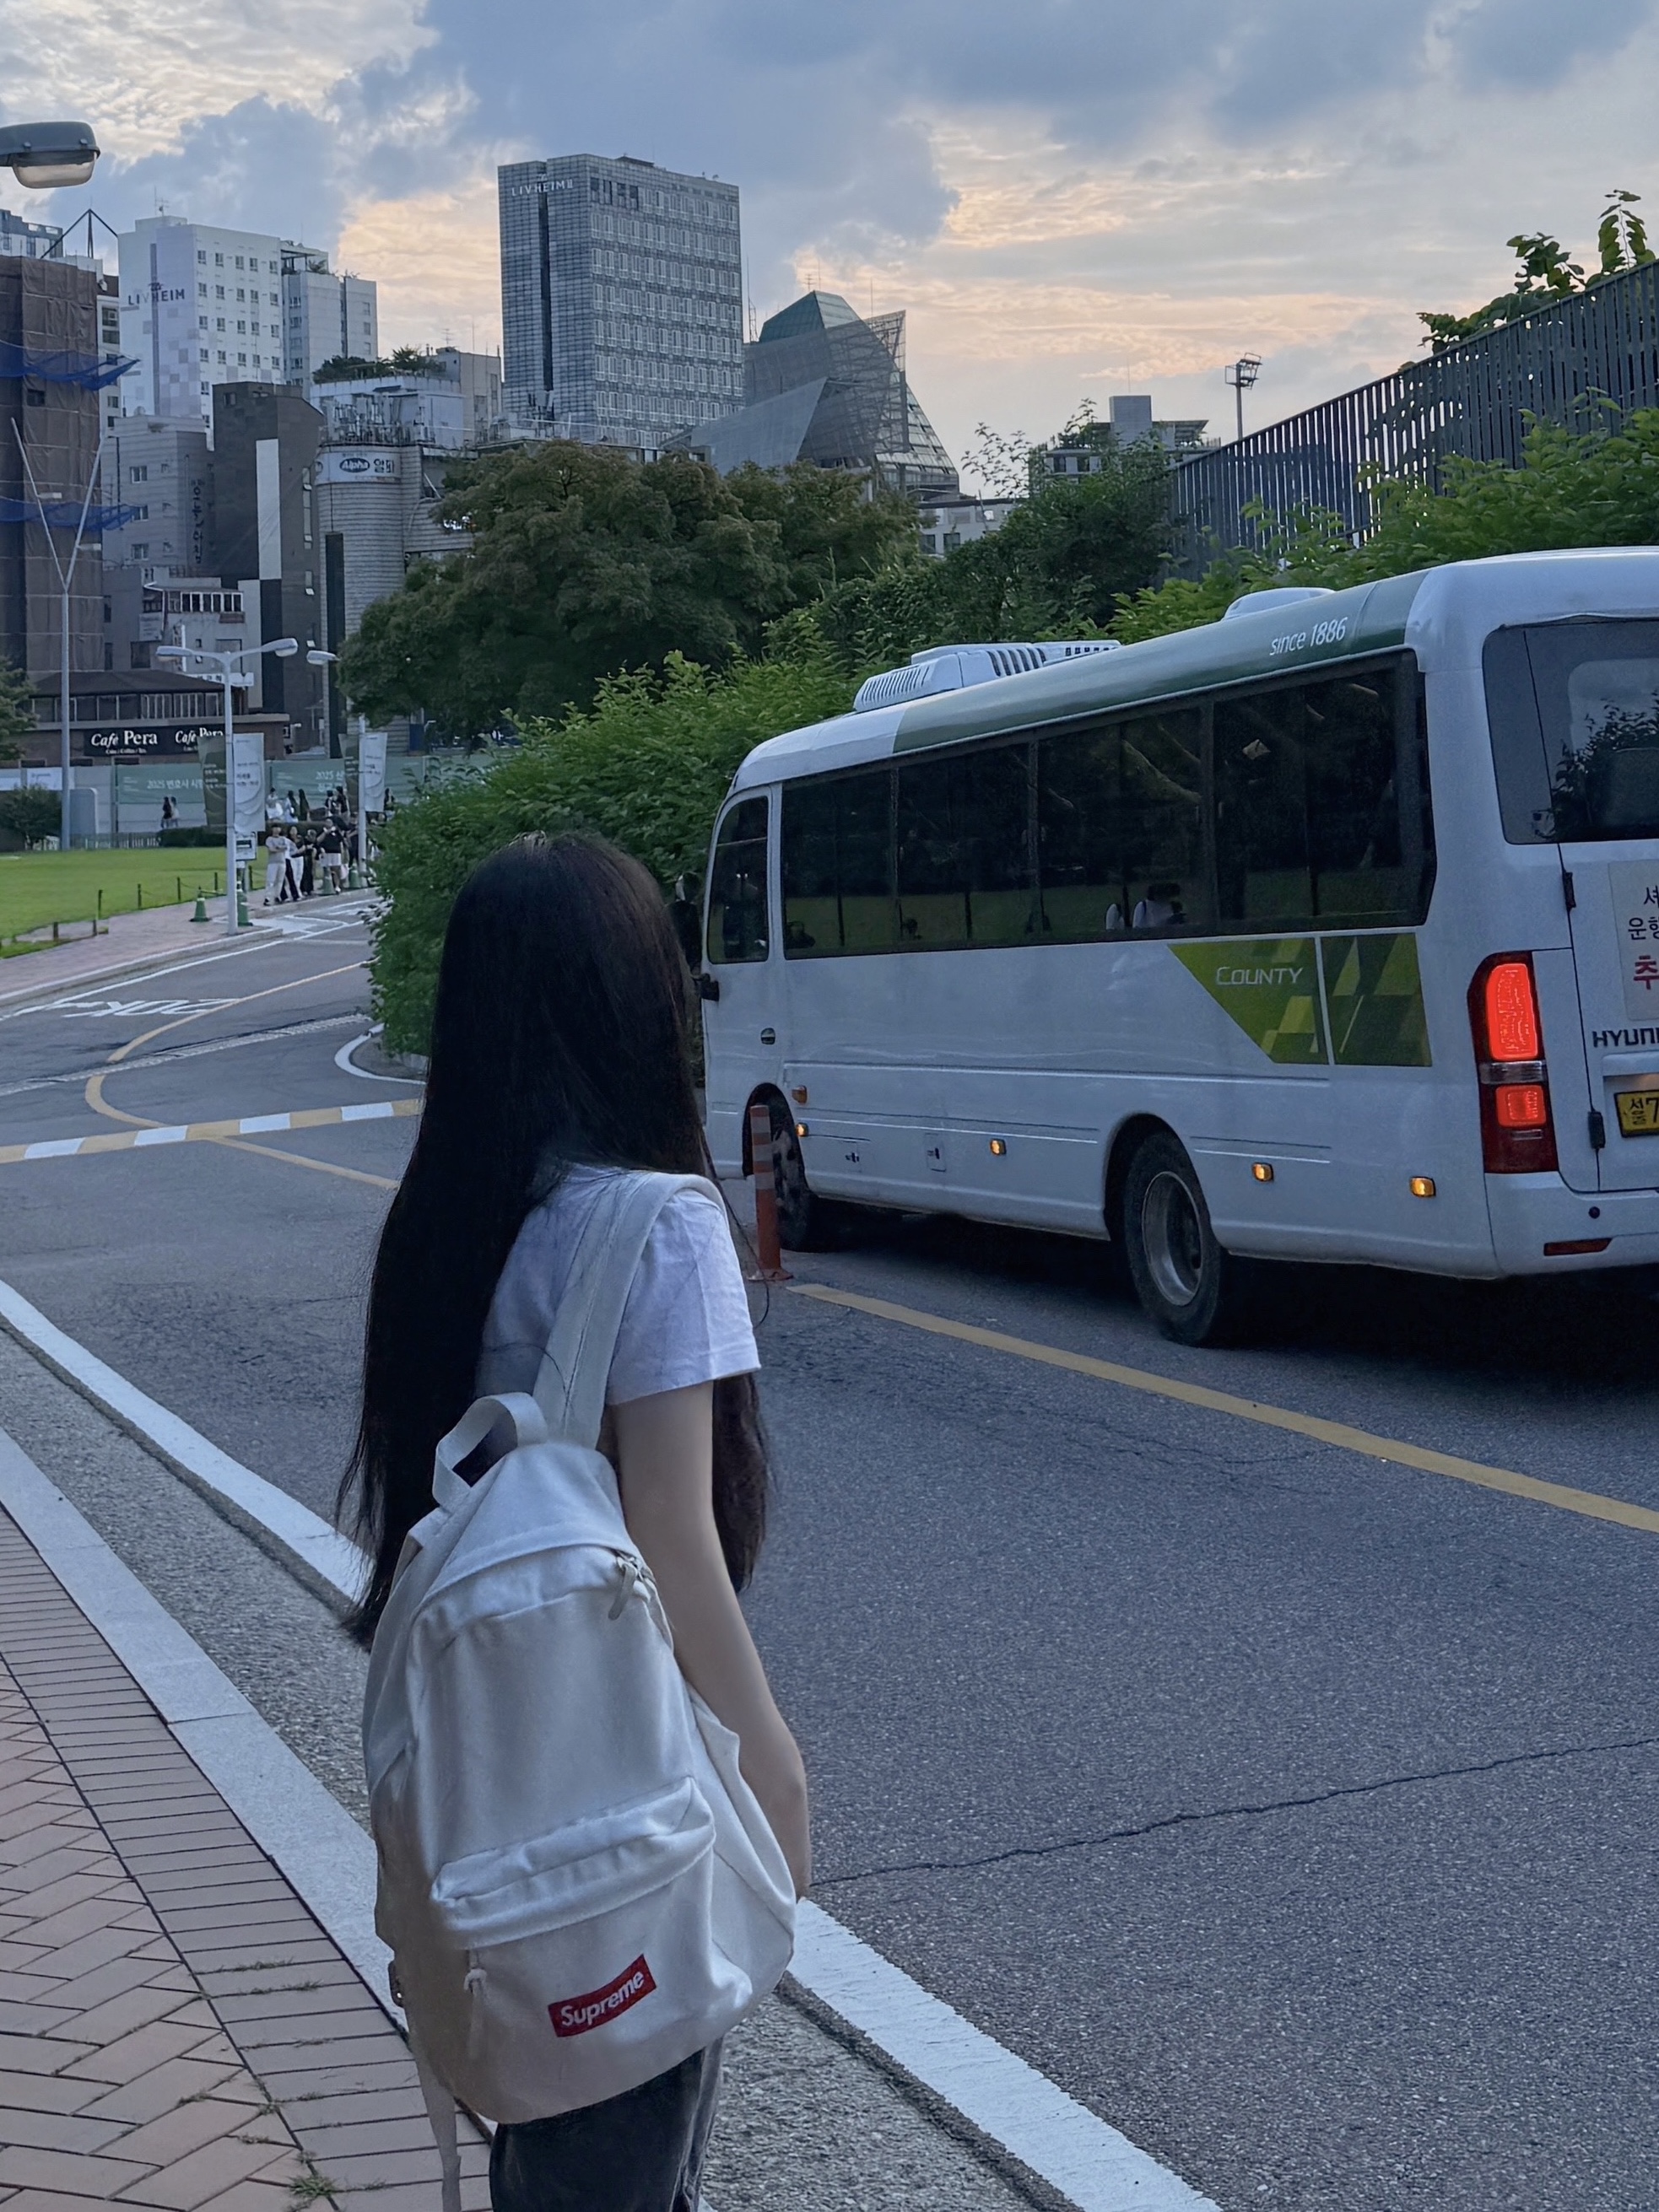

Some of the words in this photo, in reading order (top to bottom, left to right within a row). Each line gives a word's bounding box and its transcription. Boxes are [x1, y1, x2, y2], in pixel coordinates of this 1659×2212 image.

[128, 289, 185, 305] LIVHEIM
[1269, 632, 1306, 656] since
[1310, 617, 1348, 647] 1886
[124, 730, 158, 745] Pera
[1216, 966, 1304, 986] COUNTY
[1633, 955, 1659, 990] 추
[1645, 1097, 1659, 1124] 7
[559, 1971, 645, 2026] Supreme
